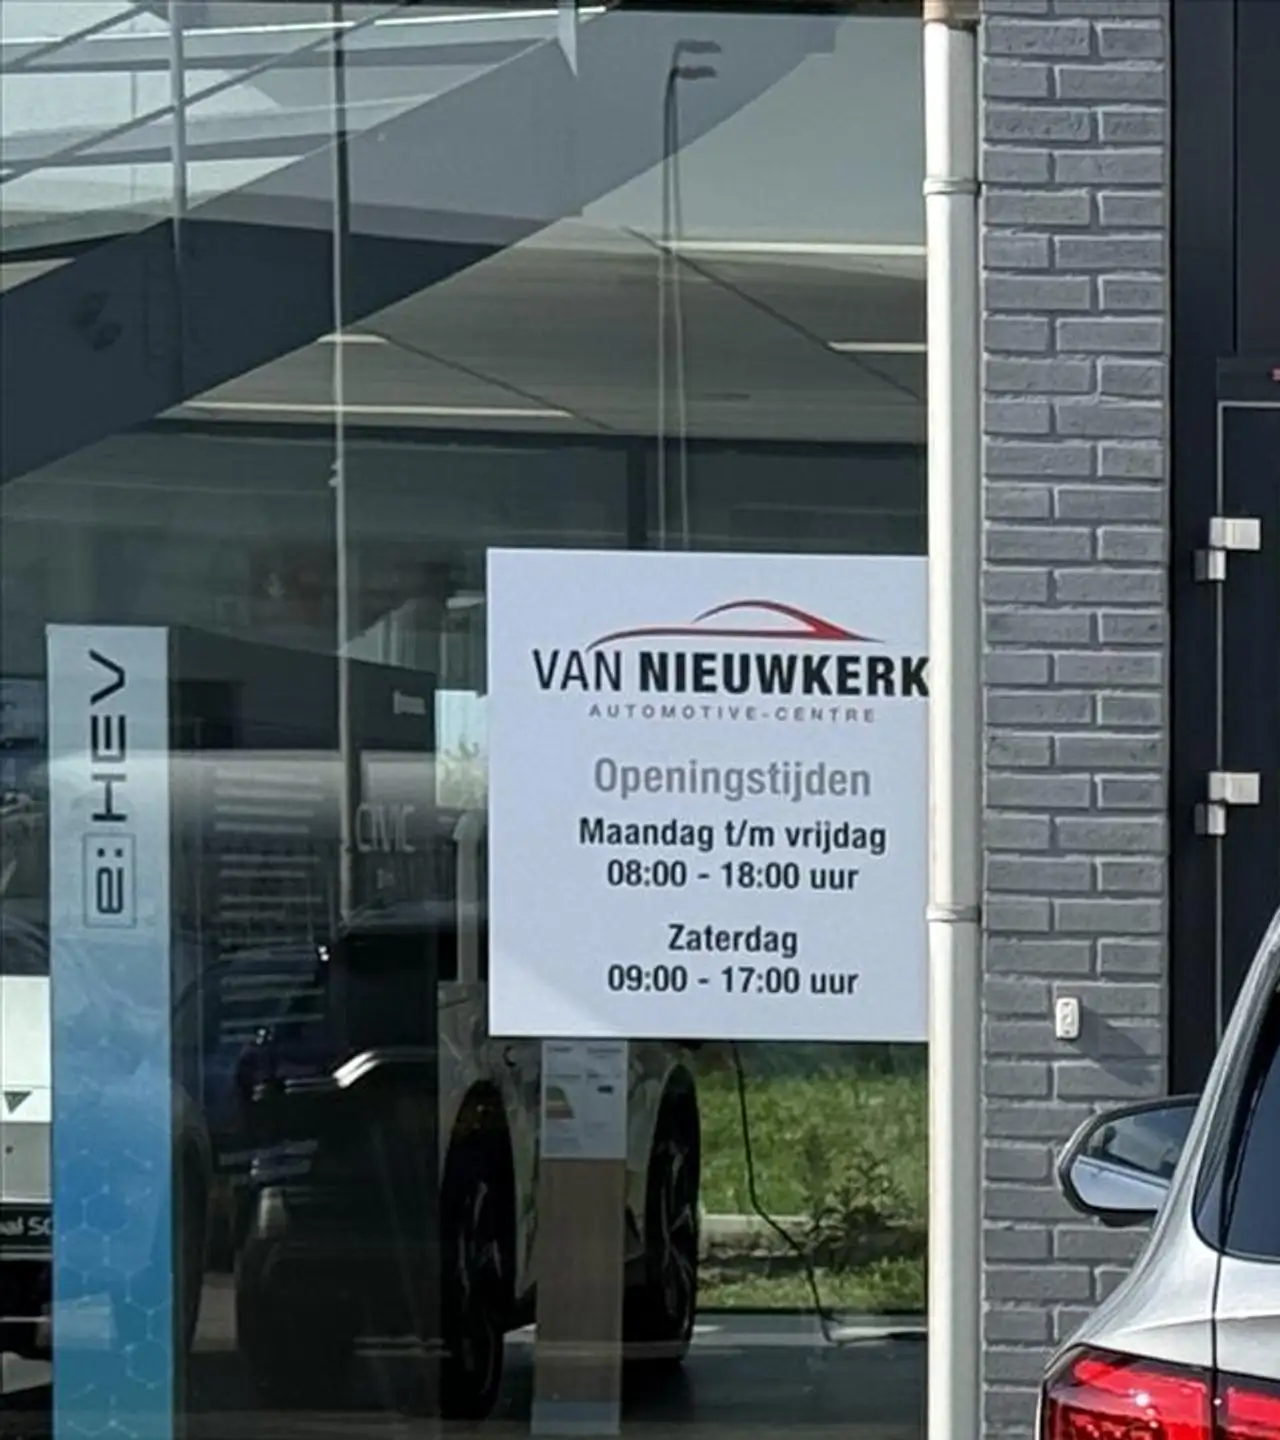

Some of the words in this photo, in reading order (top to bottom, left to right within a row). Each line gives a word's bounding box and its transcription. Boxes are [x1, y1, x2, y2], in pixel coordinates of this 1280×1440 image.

[532, 649, 622, 692] VAN
[638, 651, 930, 698] NIEUWKERK
[588, 703, 876, 724] AUTOMOTIVE-CENTRE
[594, 757, 871, 802] Openingstijden
[578, 817, 714, 852] Maandag
[724, 819, 775, 848] t/m
[785, 820, 887, 856] vrijdag
[606, 859, 688, 888] 08:00
[720, 861, 800, 890] 18:00
[809, 867, 859, 891] uur
[668, 923, 798, 960] Zaterdag
[606, 964, 688, 993] 09:00
[720, 965, 800, 994] 17:00
[810, 972, 859, 996] uur
